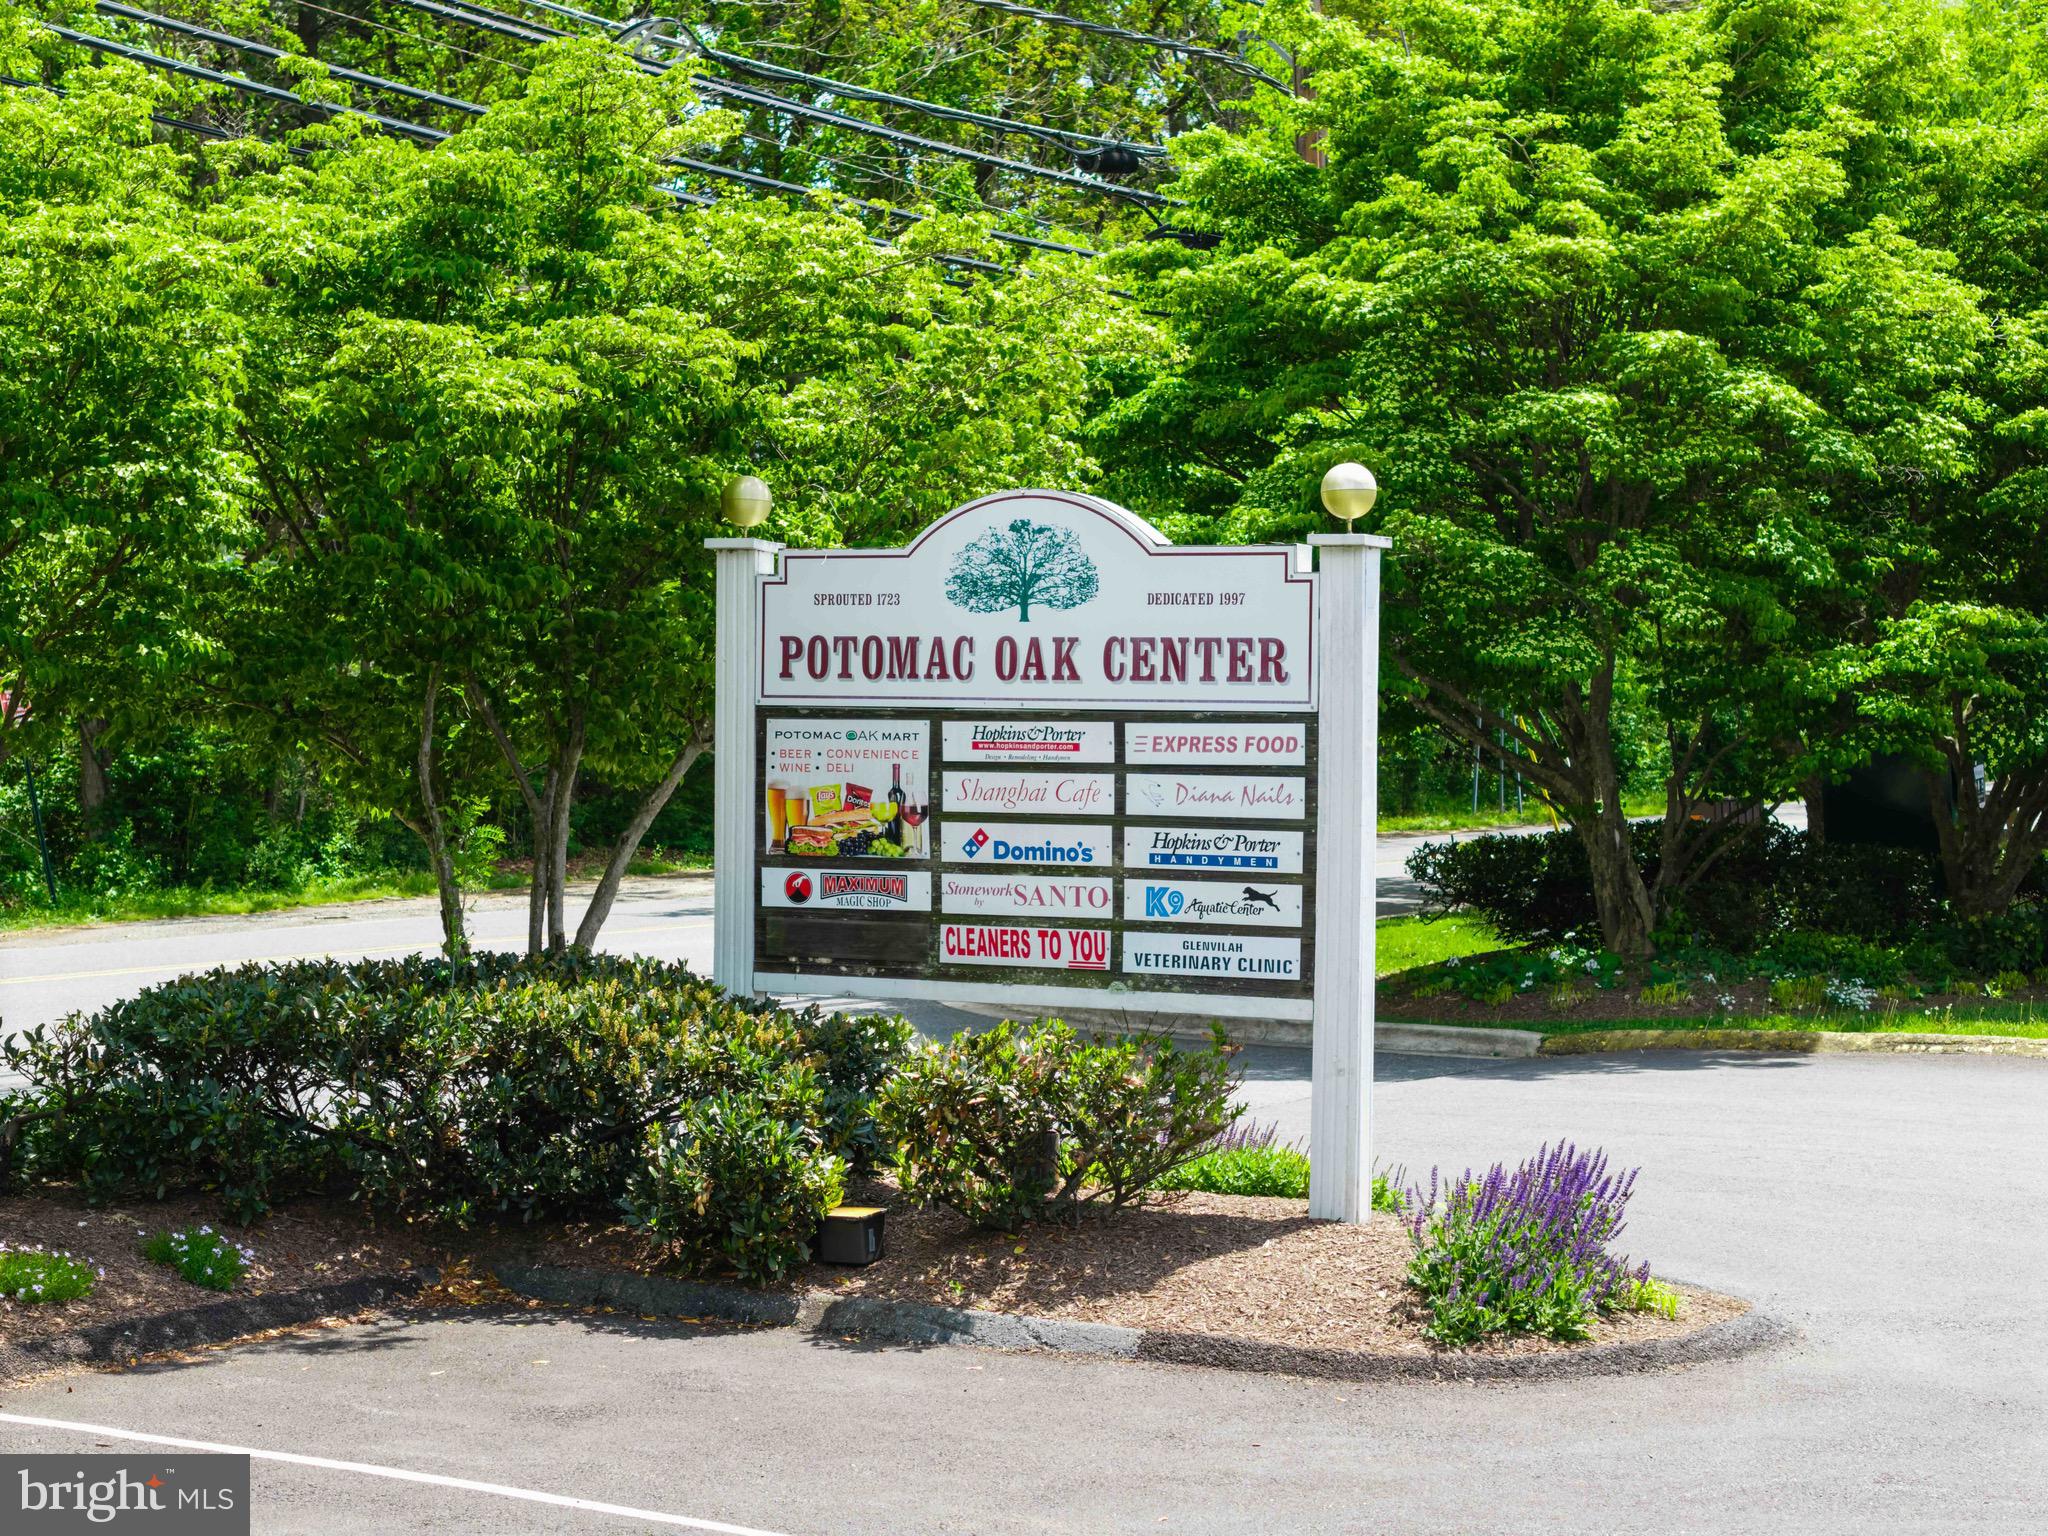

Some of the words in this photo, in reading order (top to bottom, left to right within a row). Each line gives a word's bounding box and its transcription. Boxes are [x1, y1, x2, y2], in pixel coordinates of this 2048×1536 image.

[813, 593, 874, 606] SPROUTED
[876, 593, 901, 606] 1723
[1146, 592, 1214, 605] DEDICATED
[1218, 593, 1246, 606] 1997
[778, 634, 976, 682] POTOMAC
[994, 635, 1082, 684] OAK
[1103, 636, 1290, 685] CENTER
[774, 730, 842, 740] POTOMAC
[845, 730, 878, 741] OAK
[882, 732, 920, 741] MART
[1152, 735, 1238, 753] EXPRESS
[1244, 736, 1298, 753] FOOD
[779, 749, 812, 759] BEER
[826, 749, 919, 760] CONVENIENCE
[977, 742, 1074, 751] www.hopkinsandporter.com
[779, 763, 812, 773] WINE
[826, 763, 854, 773] DELI
[957, 778, 1049, 810] Shanghai
[1055, 779, 1101, 810] Cafe
[1175, 782, 1236, 806] Diana
[1240, 783, 1295, 808] Nails
[993, 840, 1093, 862] Domino's
[1154, 855, 1273, 867] HANDYMEN
[823, 875, 906, 898] MAXIMUM
[945, 881, 1013, 897] Stonework
[1013, 884, 1109, 909] SANTO
[836, 895, 866, 907] MAGIC
[866, 896, 892, 908] SHOP
[974, 898, 985, 908] by
[1145, 886, 1185, 918] K9
[1184, 898, 1231, 920] Aquatic
[1230, 900, 1265, 916] Center
[945, 927, 1031, 959] CLEANERS
[1037, 930, 1062, 960] TO
[1068, 930, 1106, 961] YOU
[1182, 940, 1243, 953] GLENVILAH
[1133, 952, 1232, 972] VETERINARY
[1237, 957, 1293, 974] CLINIC
